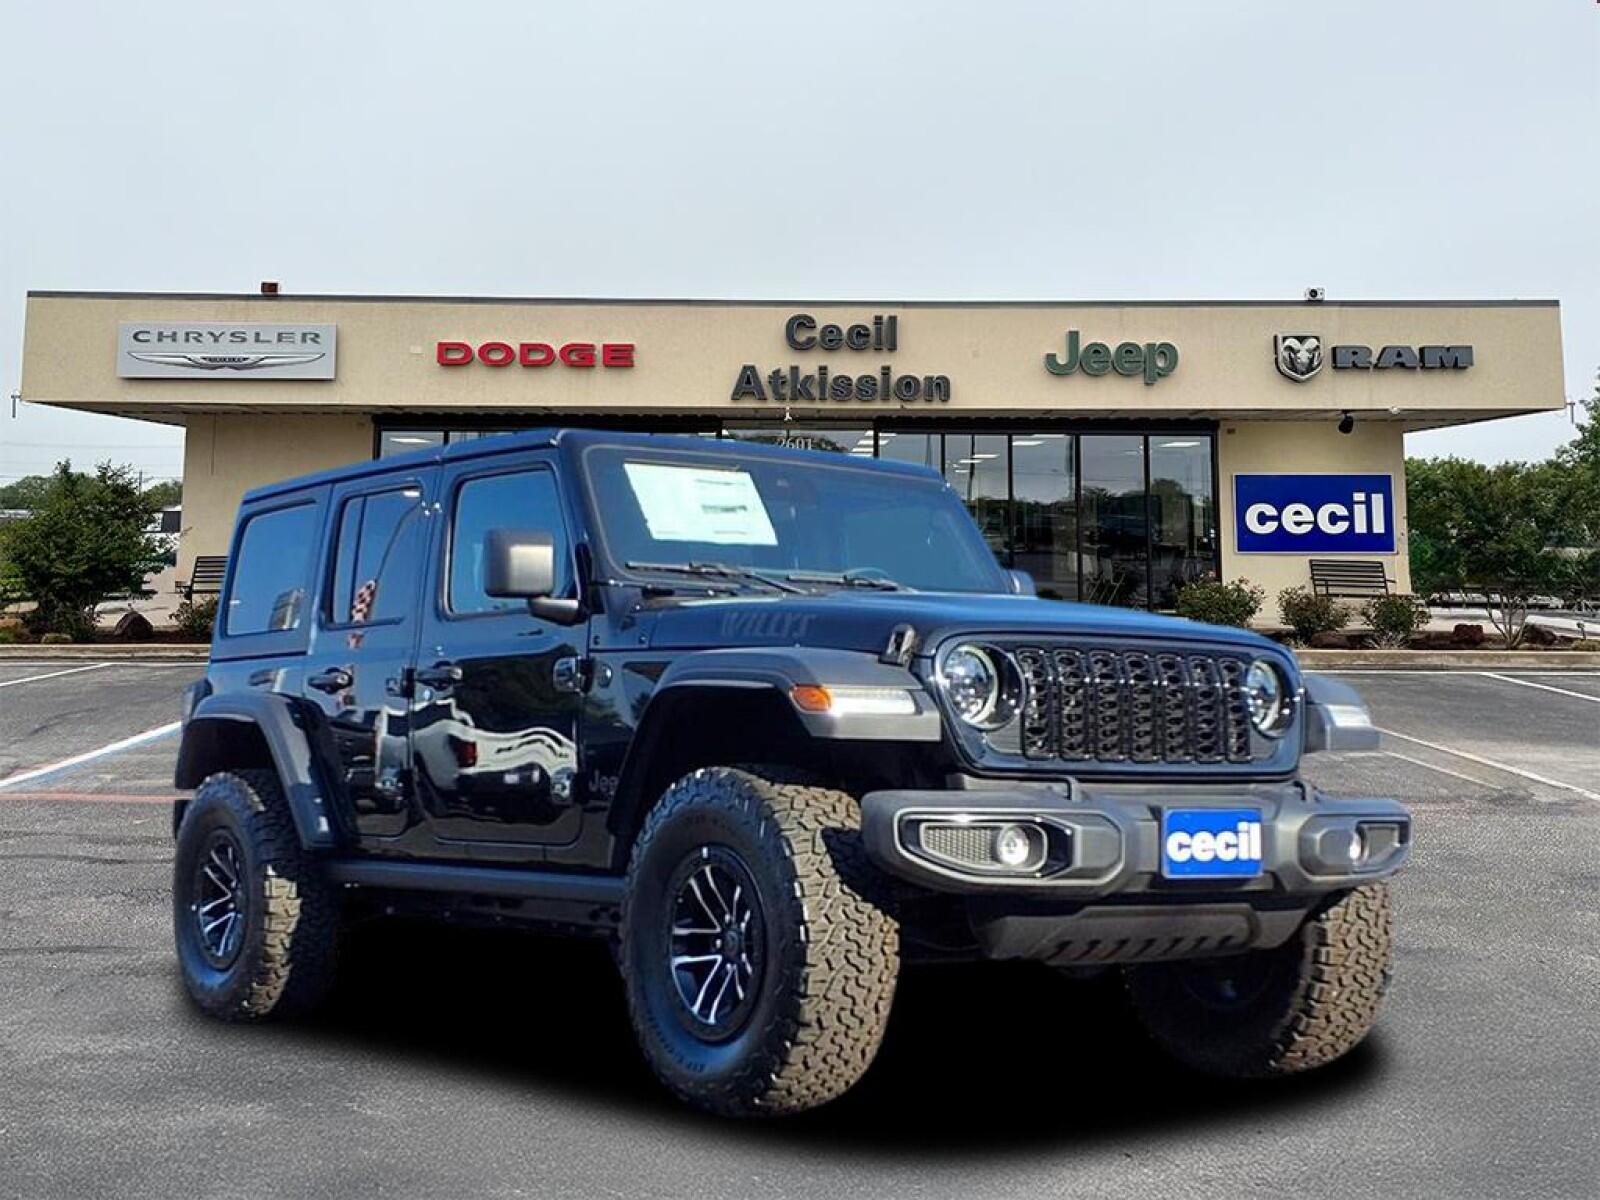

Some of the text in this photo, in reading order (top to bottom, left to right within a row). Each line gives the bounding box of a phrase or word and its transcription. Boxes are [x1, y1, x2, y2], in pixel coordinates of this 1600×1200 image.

[132, 330, 321, 345] CHRYSLER
[785, 313, 898, 351] Cecil
[436, 341, 635, 368] DODGE
[1045, 330, 1179, 386] Jeep
[1331, 345, 1474, 369] RAM
[731, 364, 951, 402] Atkission
[1244, 491, 1386, 535] cecil
[1166, 821, 1262, 862] cecil
